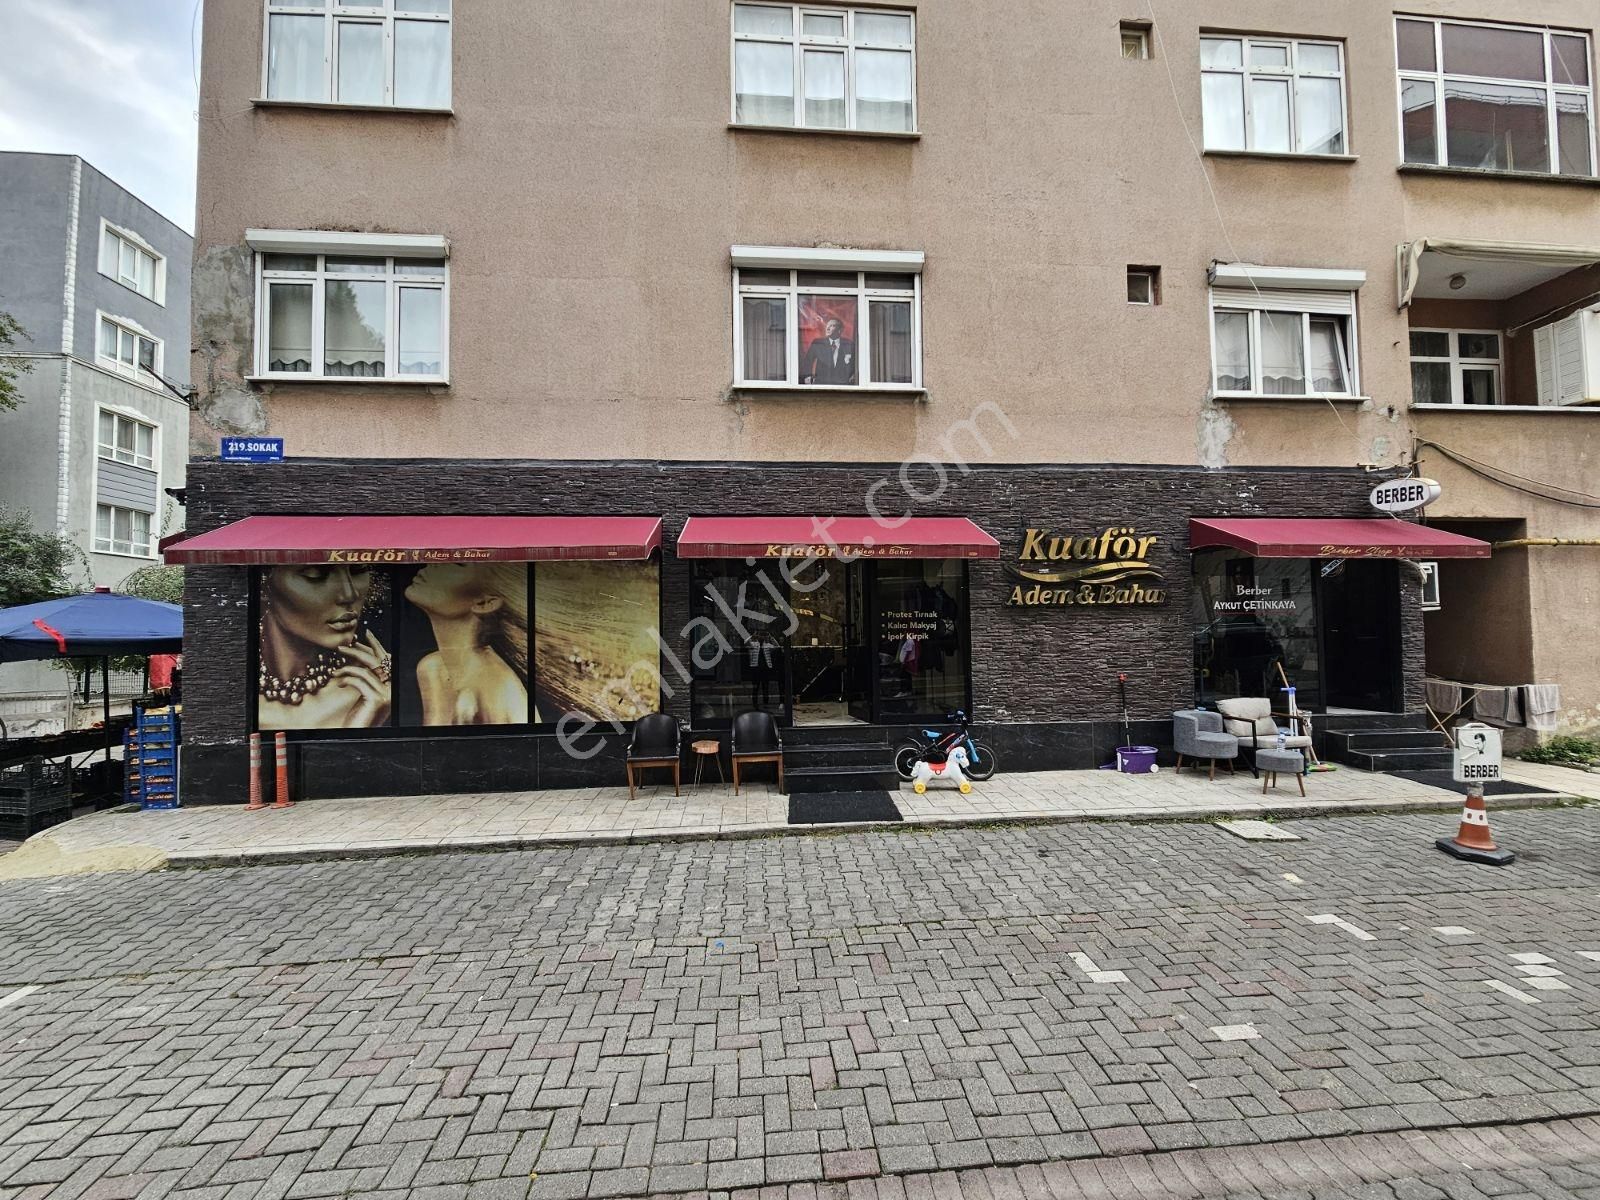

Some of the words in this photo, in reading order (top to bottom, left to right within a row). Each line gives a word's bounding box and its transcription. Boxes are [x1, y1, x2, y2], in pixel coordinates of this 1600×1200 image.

[228, 442, 278, 452] 219.SOKAK
[1376, 485, 1424, 505] BERBER
[1018, 527, 1157, 560] Kuaför
[328, 549, 406, 562] Kuaför
[424, 551, 450, 560] Adem
[464, 550, 491, 558] Bahar
[765, 544, 836, 557] Kuaför
[853, 547, 875, 556] Adem
[889, 546, 913, 555] Bahar
[1365, 546, 1393, 557] Shop
[1005, 585, 1074, 605] Adem
[1075, 584, 1096, 605] &
[1236, 584, 1272, 596] Berber
[1213, 601, 1241, 610] AYKUT
[1243, 599, 1296, 612] ÇETİNKAYA
[910, 621, 937, 631] Makyaj
[906, 632, 929, 642] Kirpik
[1464, 764, 1499, 778] BERBER
